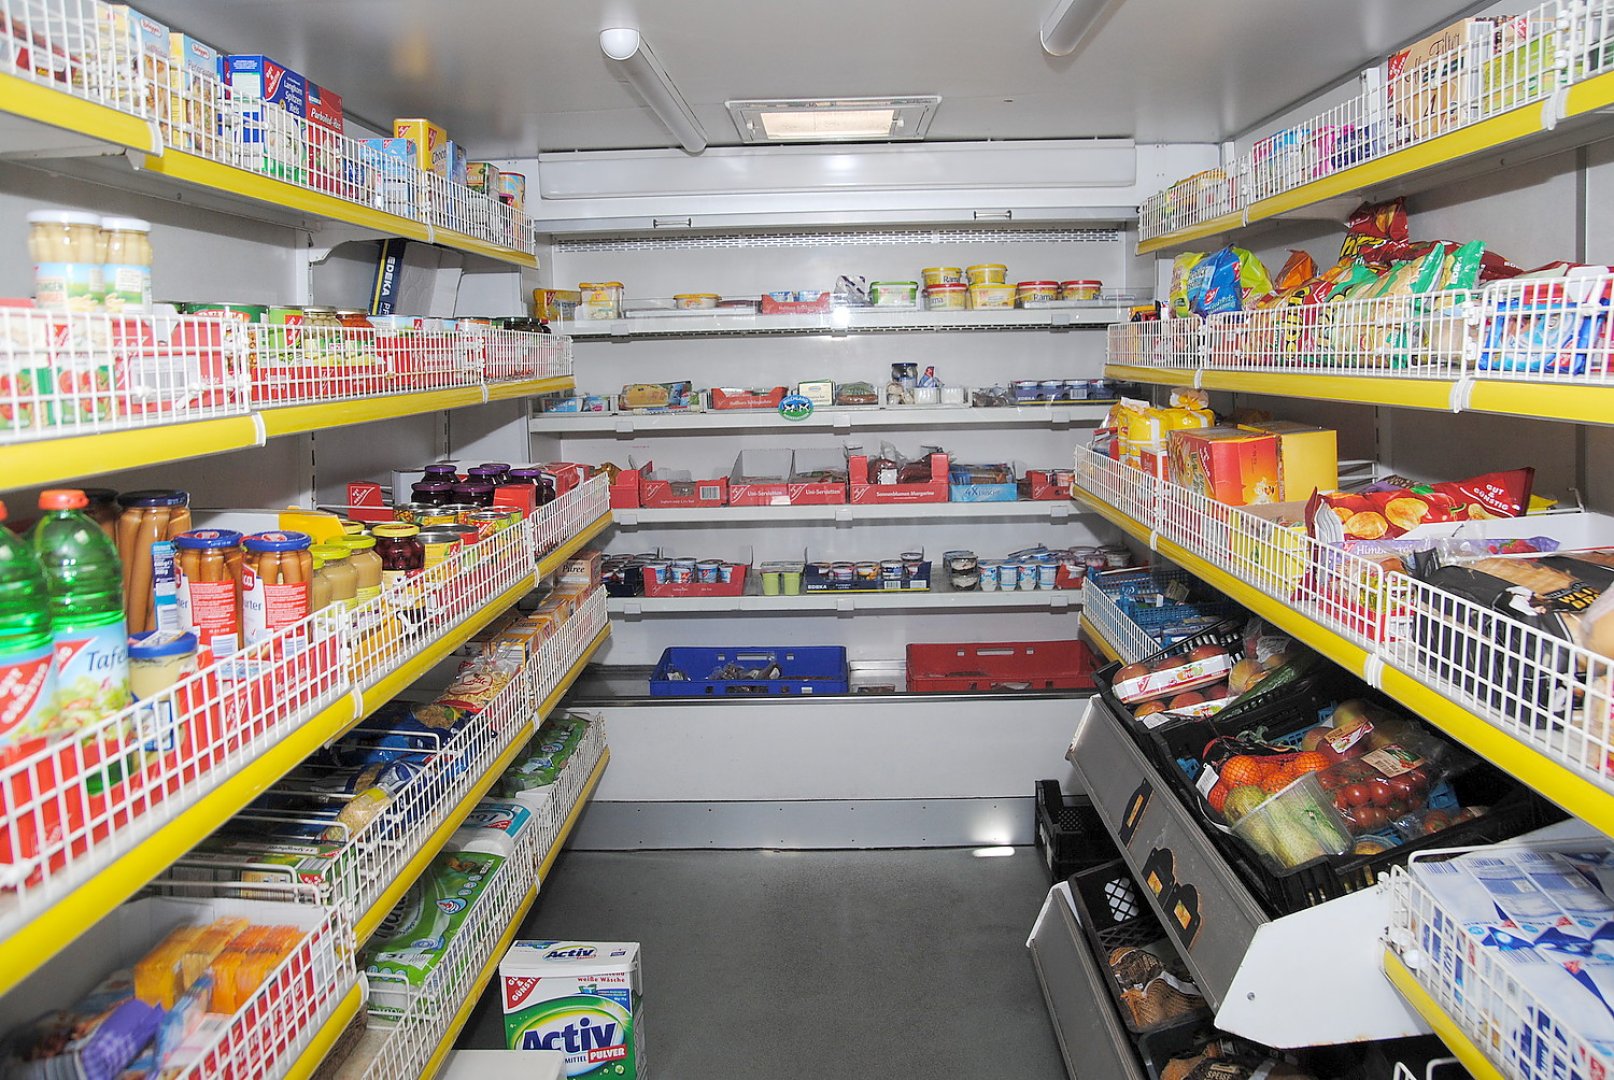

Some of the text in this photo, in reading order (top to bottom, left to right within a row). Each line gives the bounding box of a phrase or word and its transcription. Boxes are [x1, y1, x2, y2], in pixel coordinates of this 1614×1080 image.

[382, 255, 396, 296] EDEKA
[1033, 293, 1055, 302] Rama
[1473, 487, 1509, 511] GÜNSTIG
[1486, 484, 1505, 495] GUT
[87, 645, 127, 673] Tafe
[546, 947, 595, 958] Activ
[511, 977, 537, 1001] GÜNSTI
[522, 1017, 617, 1054] Activ
[590, 1047, 626, 1061] PULVER
